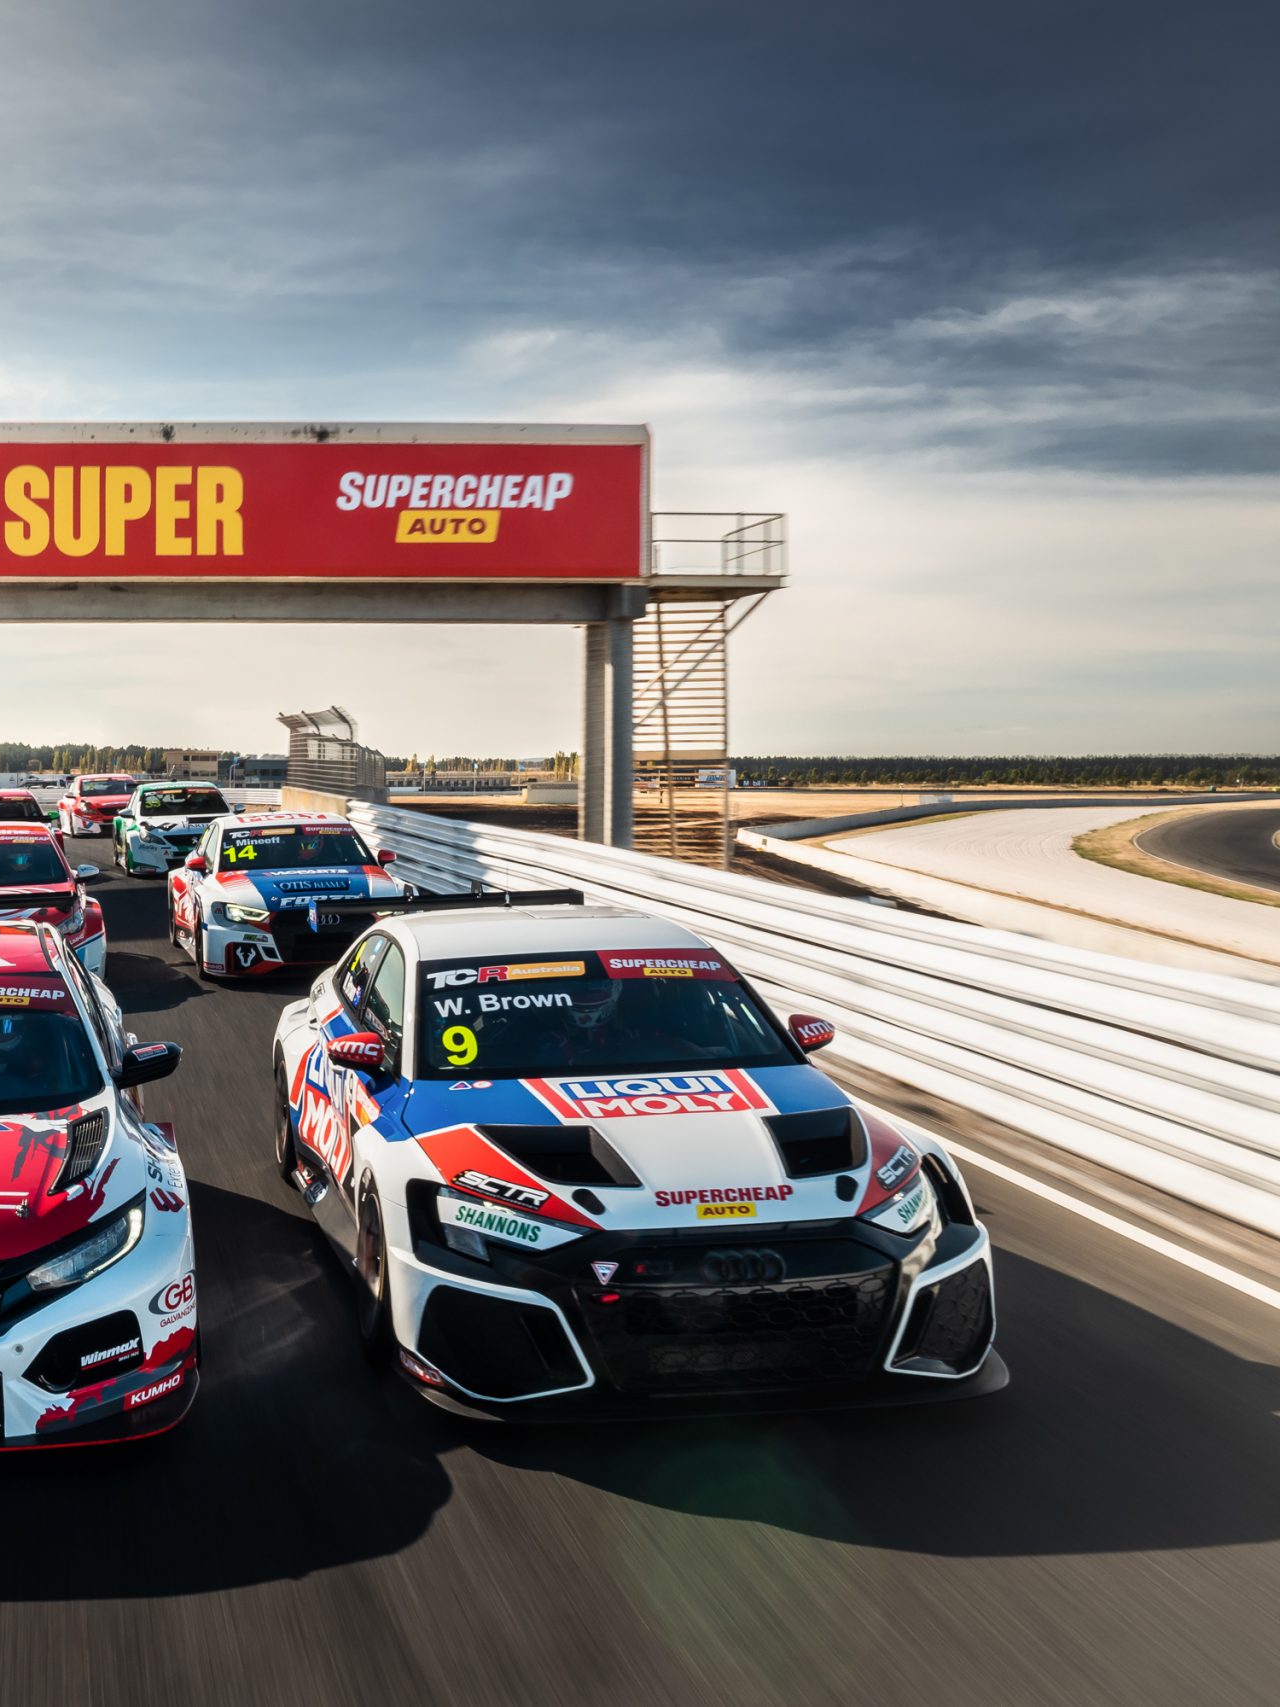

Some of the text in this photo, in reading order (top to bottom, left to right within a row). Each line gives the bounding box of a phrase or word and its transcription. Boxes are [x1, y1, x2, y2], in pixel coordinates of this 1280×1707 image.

[336, 472, 573, 512] SUPERCHEAP
[4, 465, 243, 557] SUPER
[407, 518, 487, 535] AUTO
[229, 830, 263, 838] TCR
[223, 845, 257, 863] 14
[279, 881, 311, 890] OTIS
[609, 958, 721, 971] SUPERCHEAP
[426, 965, 509, 990] TCR
[433, 992, 573, 1018] W. Brown
[442, 1025, 479, 1066] 9
[568, 1076, 725, 1099] LIQUI
[581, 1092, 735, 1117] MOLY
[458, 1170, 550, 1207] SCTR
[655, 1184, 794, 1208] SUPERCHEAP
[703, 1205, 751, 1216] AUTO
[455, 1205, 542, 1243] SHANNONS
[165, 1274, 193, 1310] GB
[130, 1375, 181, 1405] KUMHO
